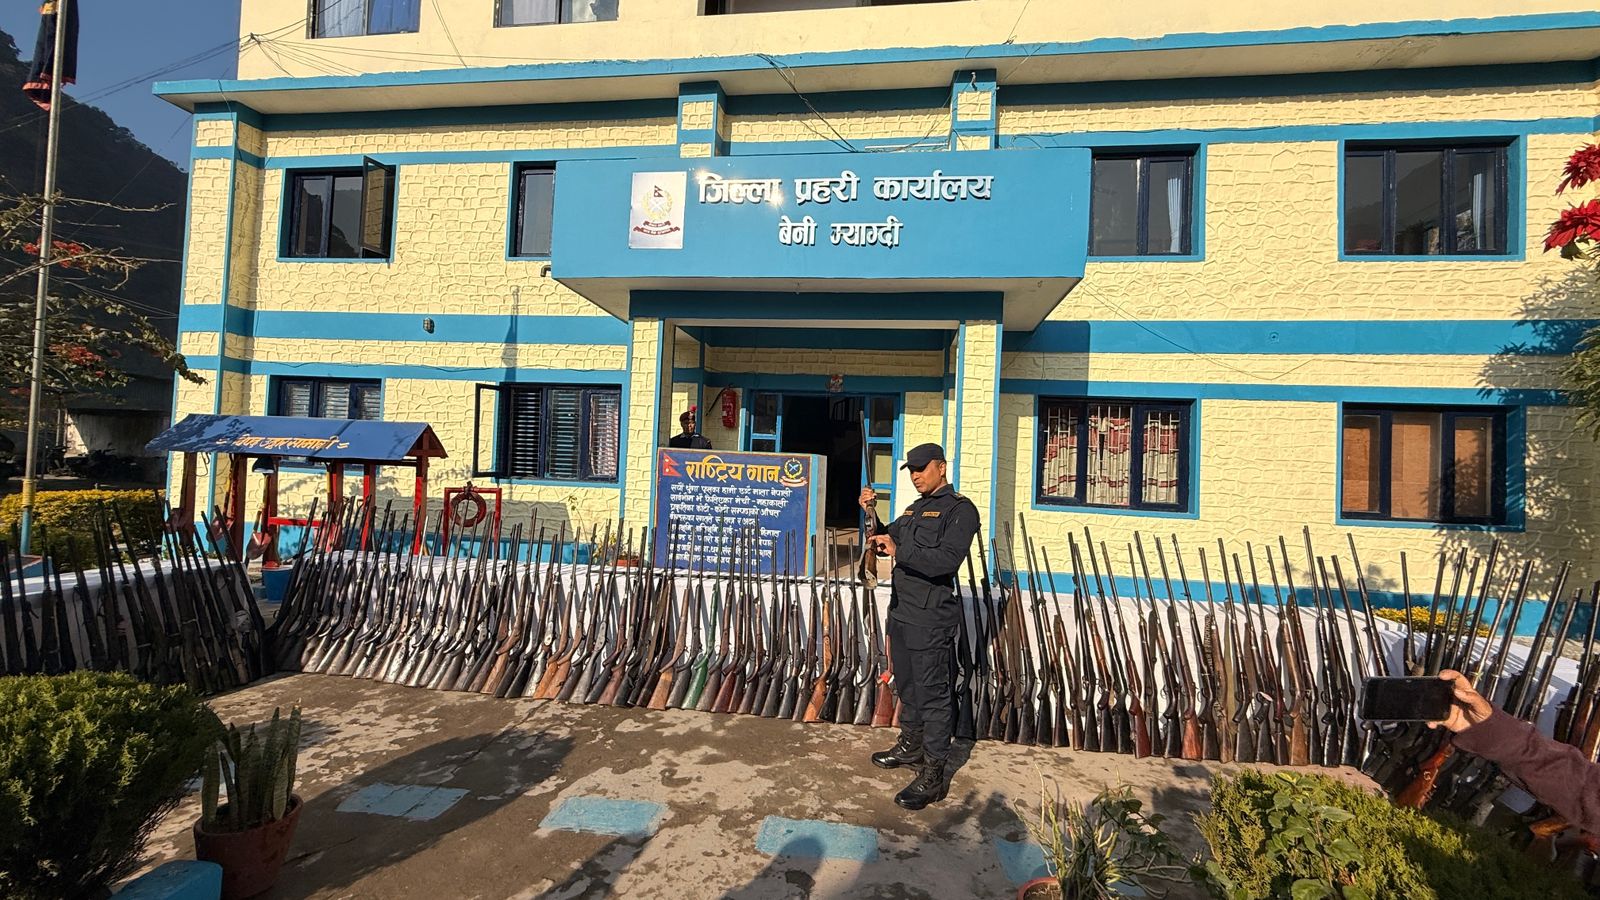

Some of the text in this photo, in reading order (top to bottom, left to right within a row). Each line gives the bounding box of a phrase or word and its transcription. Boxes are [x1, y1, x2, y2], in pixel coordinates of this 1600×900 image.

[698, 169, 994, 205] जिल्ला प्रहरी कार्यालय
[779, 215, 817, 246] बेनी
[685, 455, 781, 483] राष्ट्रिय गान
